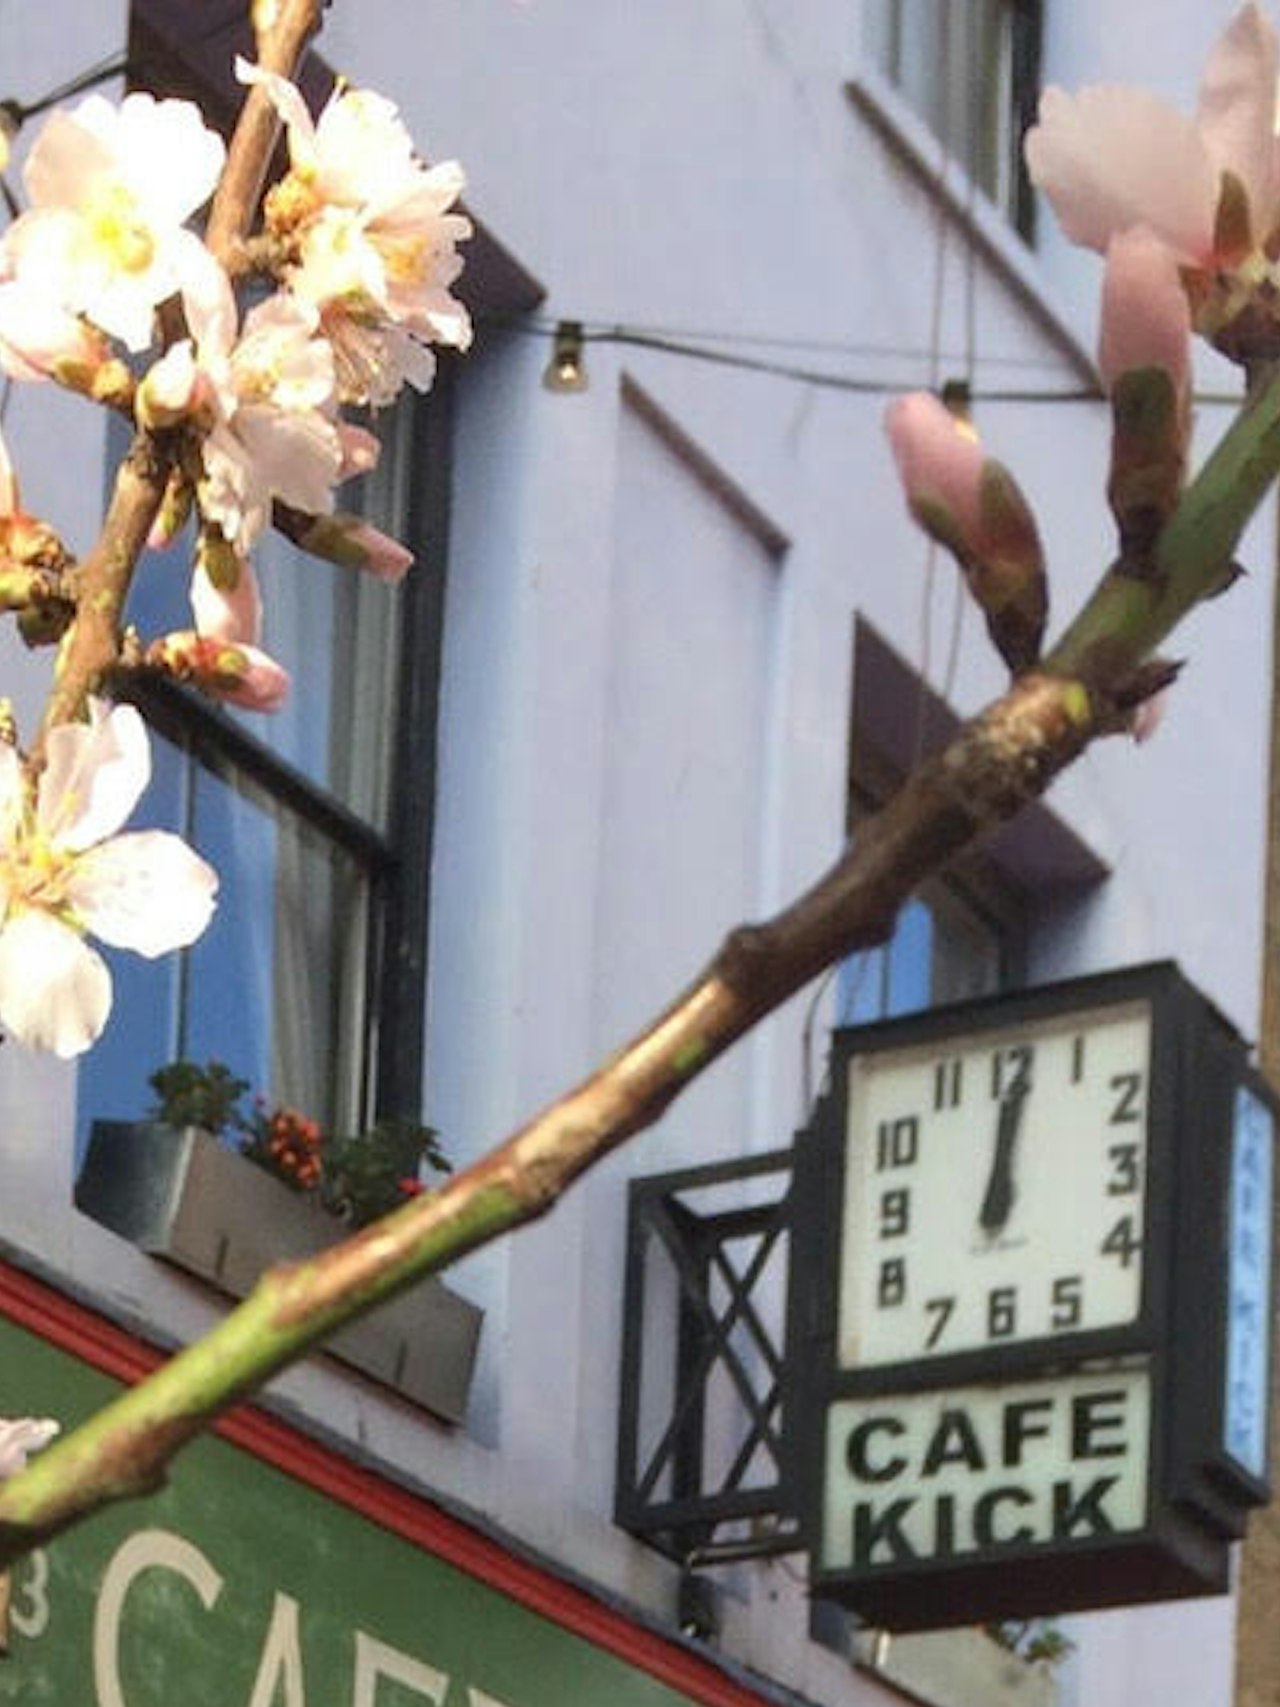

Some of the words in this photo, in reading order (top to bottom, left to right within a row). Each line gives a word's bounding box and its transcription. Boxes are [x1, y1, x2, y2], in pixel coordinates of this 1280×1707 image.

[931, 1057, 962, 1111] 11
[991, 1046, 1034, 1100] 12
[1109, 1074, 1141, 1126] 2
[876, 1115, 918, 1173] 10
[1108, 1144, 1140, 1196] 3
[879, 1188, 911, 1240] 9
[1100, 1215, 1142, 1269] 4
[877, 1257, 906, 1310] 8
[1051, 1275, 1083, 1330] 5
[924, 1297, 956, 1350] 7
[988, 1286, 1017, 1339] 6
[845, 1391, 1128, 1484] CAFE
[850, 1475, 1123, 1567] KICK
